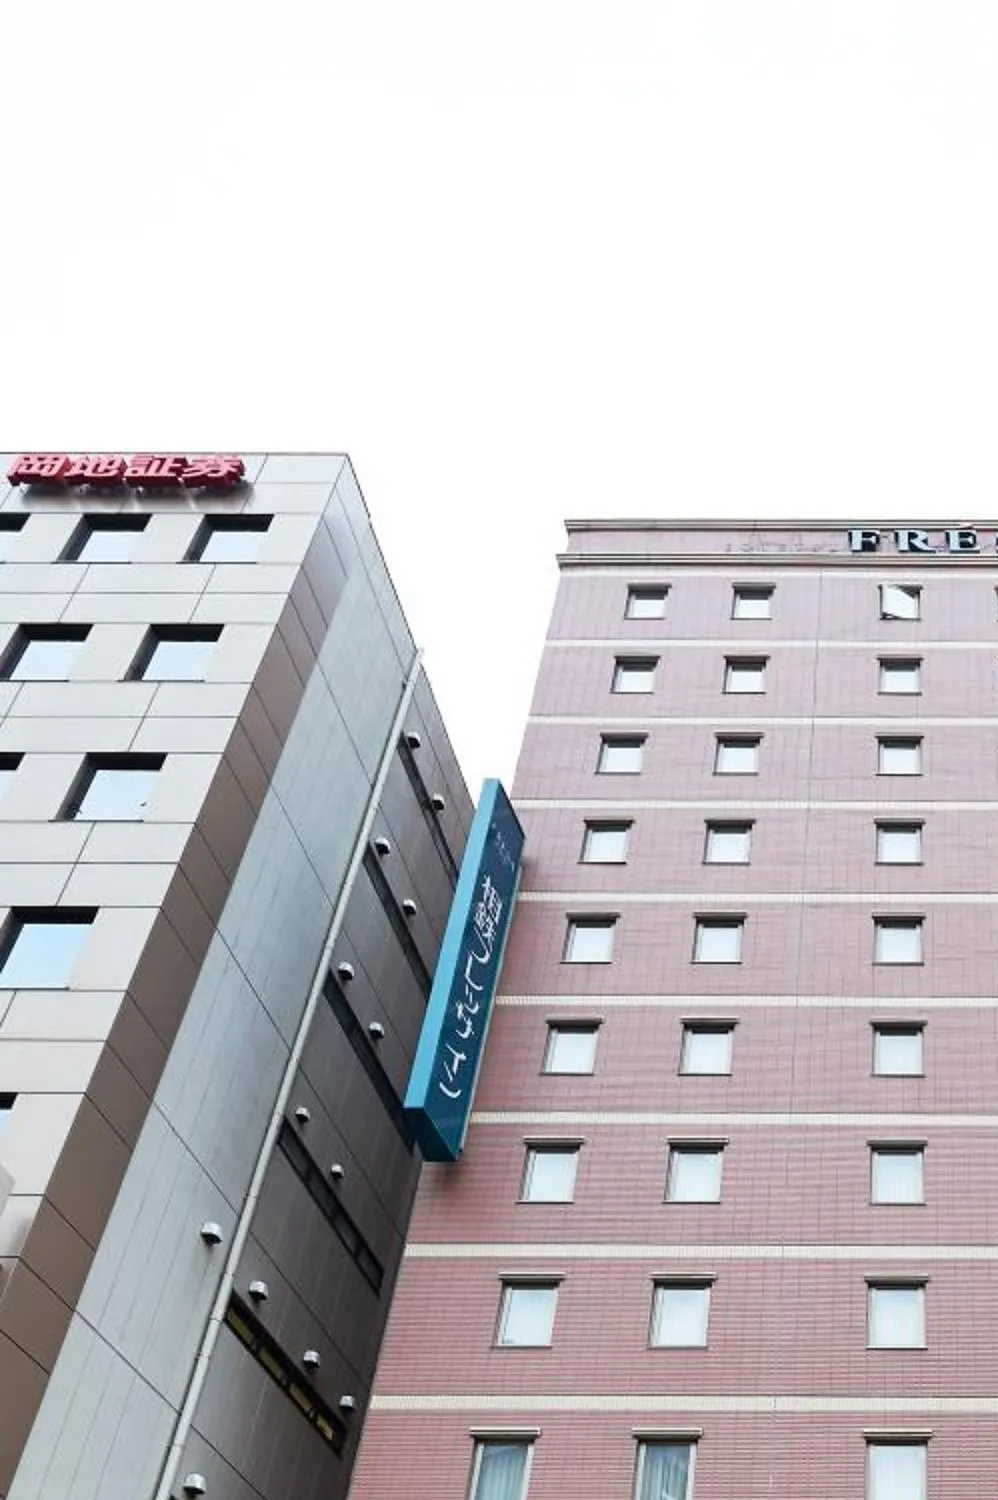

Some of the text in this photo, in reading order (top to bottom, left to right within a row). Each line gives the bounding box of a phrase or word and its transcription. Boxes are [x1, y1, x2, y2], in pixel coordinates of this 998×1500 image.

[439, 875, 503, 1099] 相鉄フレッサイン
